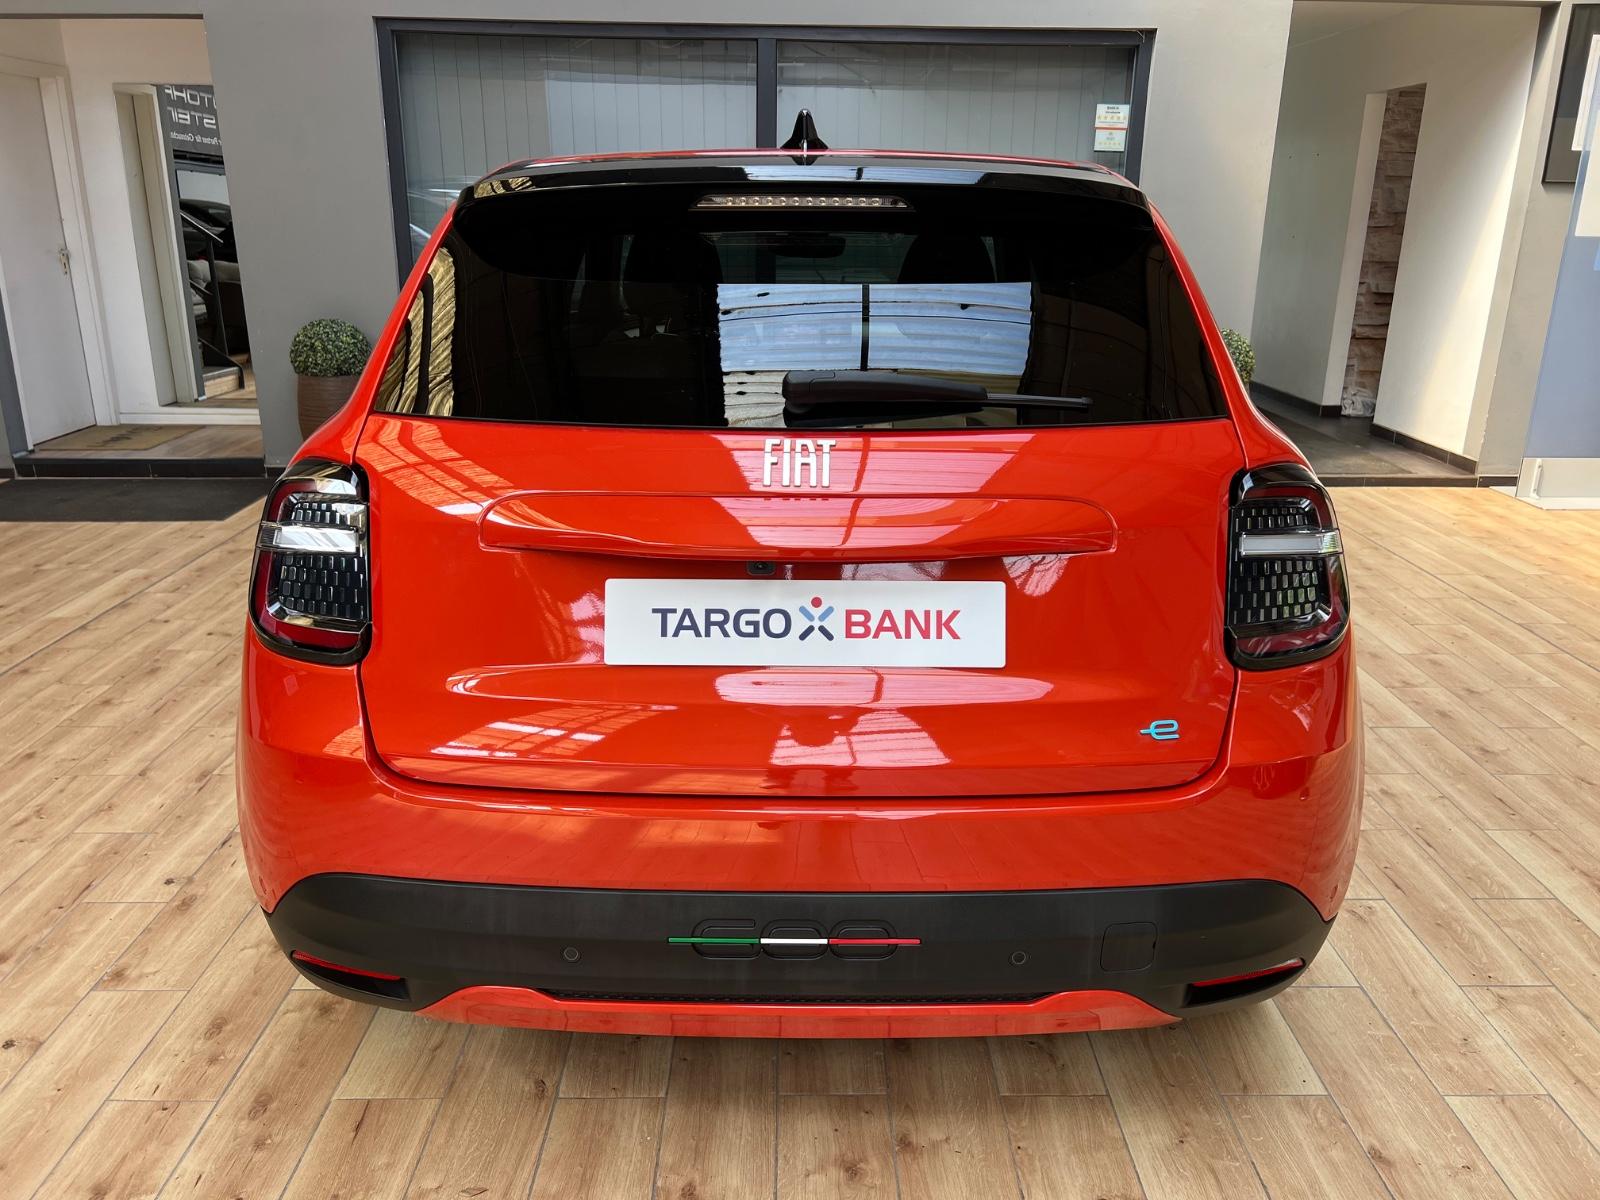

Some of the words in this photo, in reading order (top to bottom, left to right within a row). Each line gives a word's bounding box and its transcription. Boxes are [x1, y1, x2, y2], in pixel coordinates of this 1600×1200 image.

[763, 438, 836, 487] FIAT
[651, 608, 792, 638] TARGO
[844, 609, 961, 639] BANK
